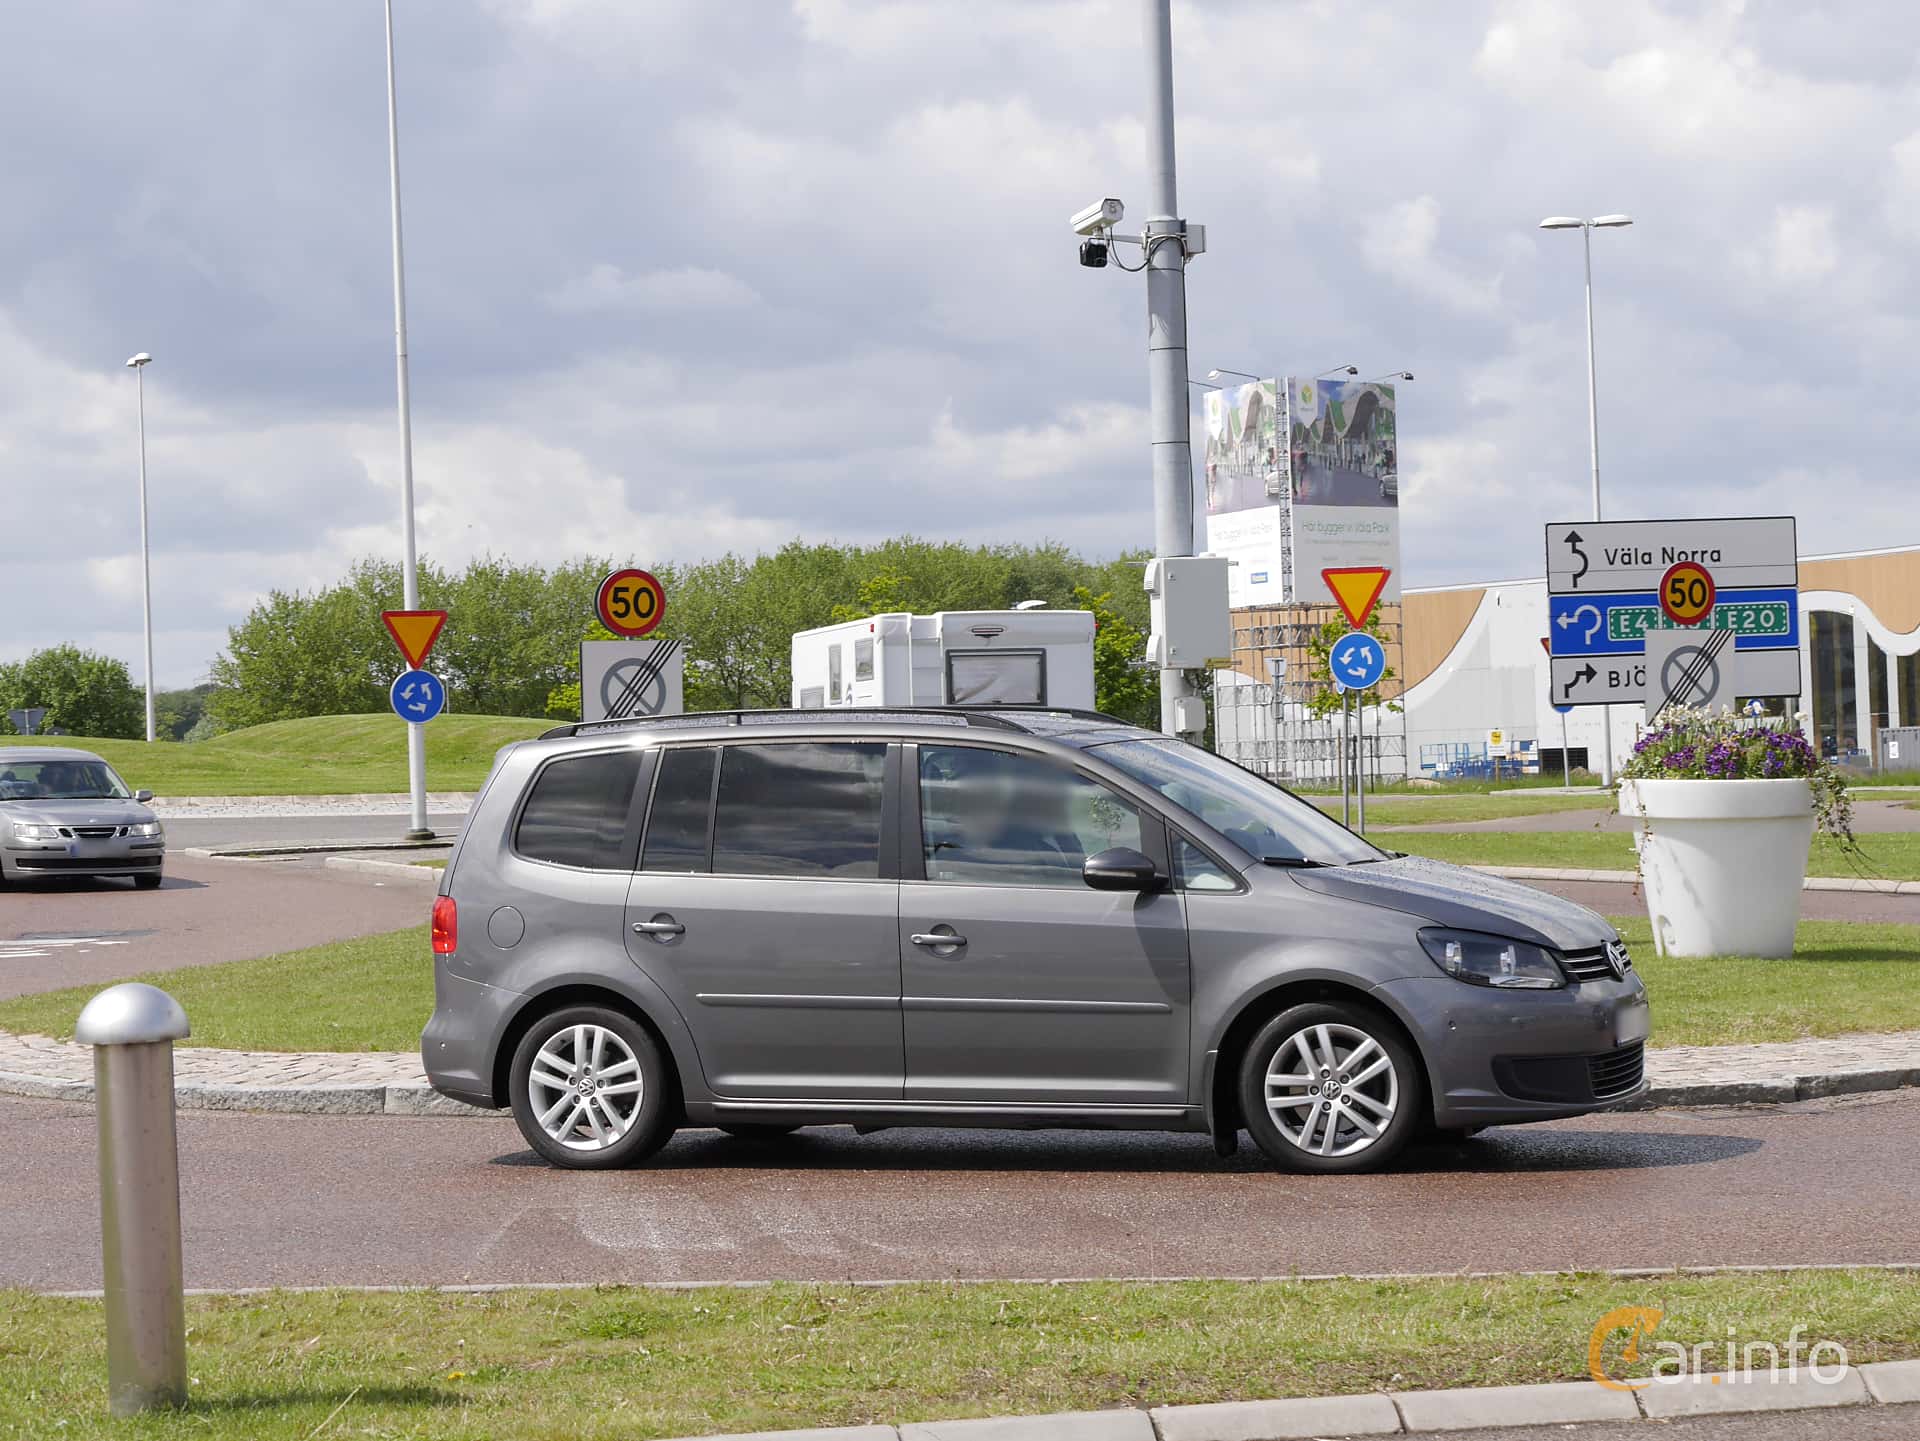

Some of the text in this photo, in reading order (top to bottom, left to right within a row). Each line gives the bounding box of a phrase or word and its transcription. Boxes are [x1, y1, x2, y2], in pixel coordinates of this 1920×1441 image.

[1604, 547, 1721, 565] Väla Norra
[1670, 578, 1707, 608] 50
[612, 587, 655, 619] 50
[1620, 614, 1648, 633] E4
[1728, 610, 1775, 629] E20
